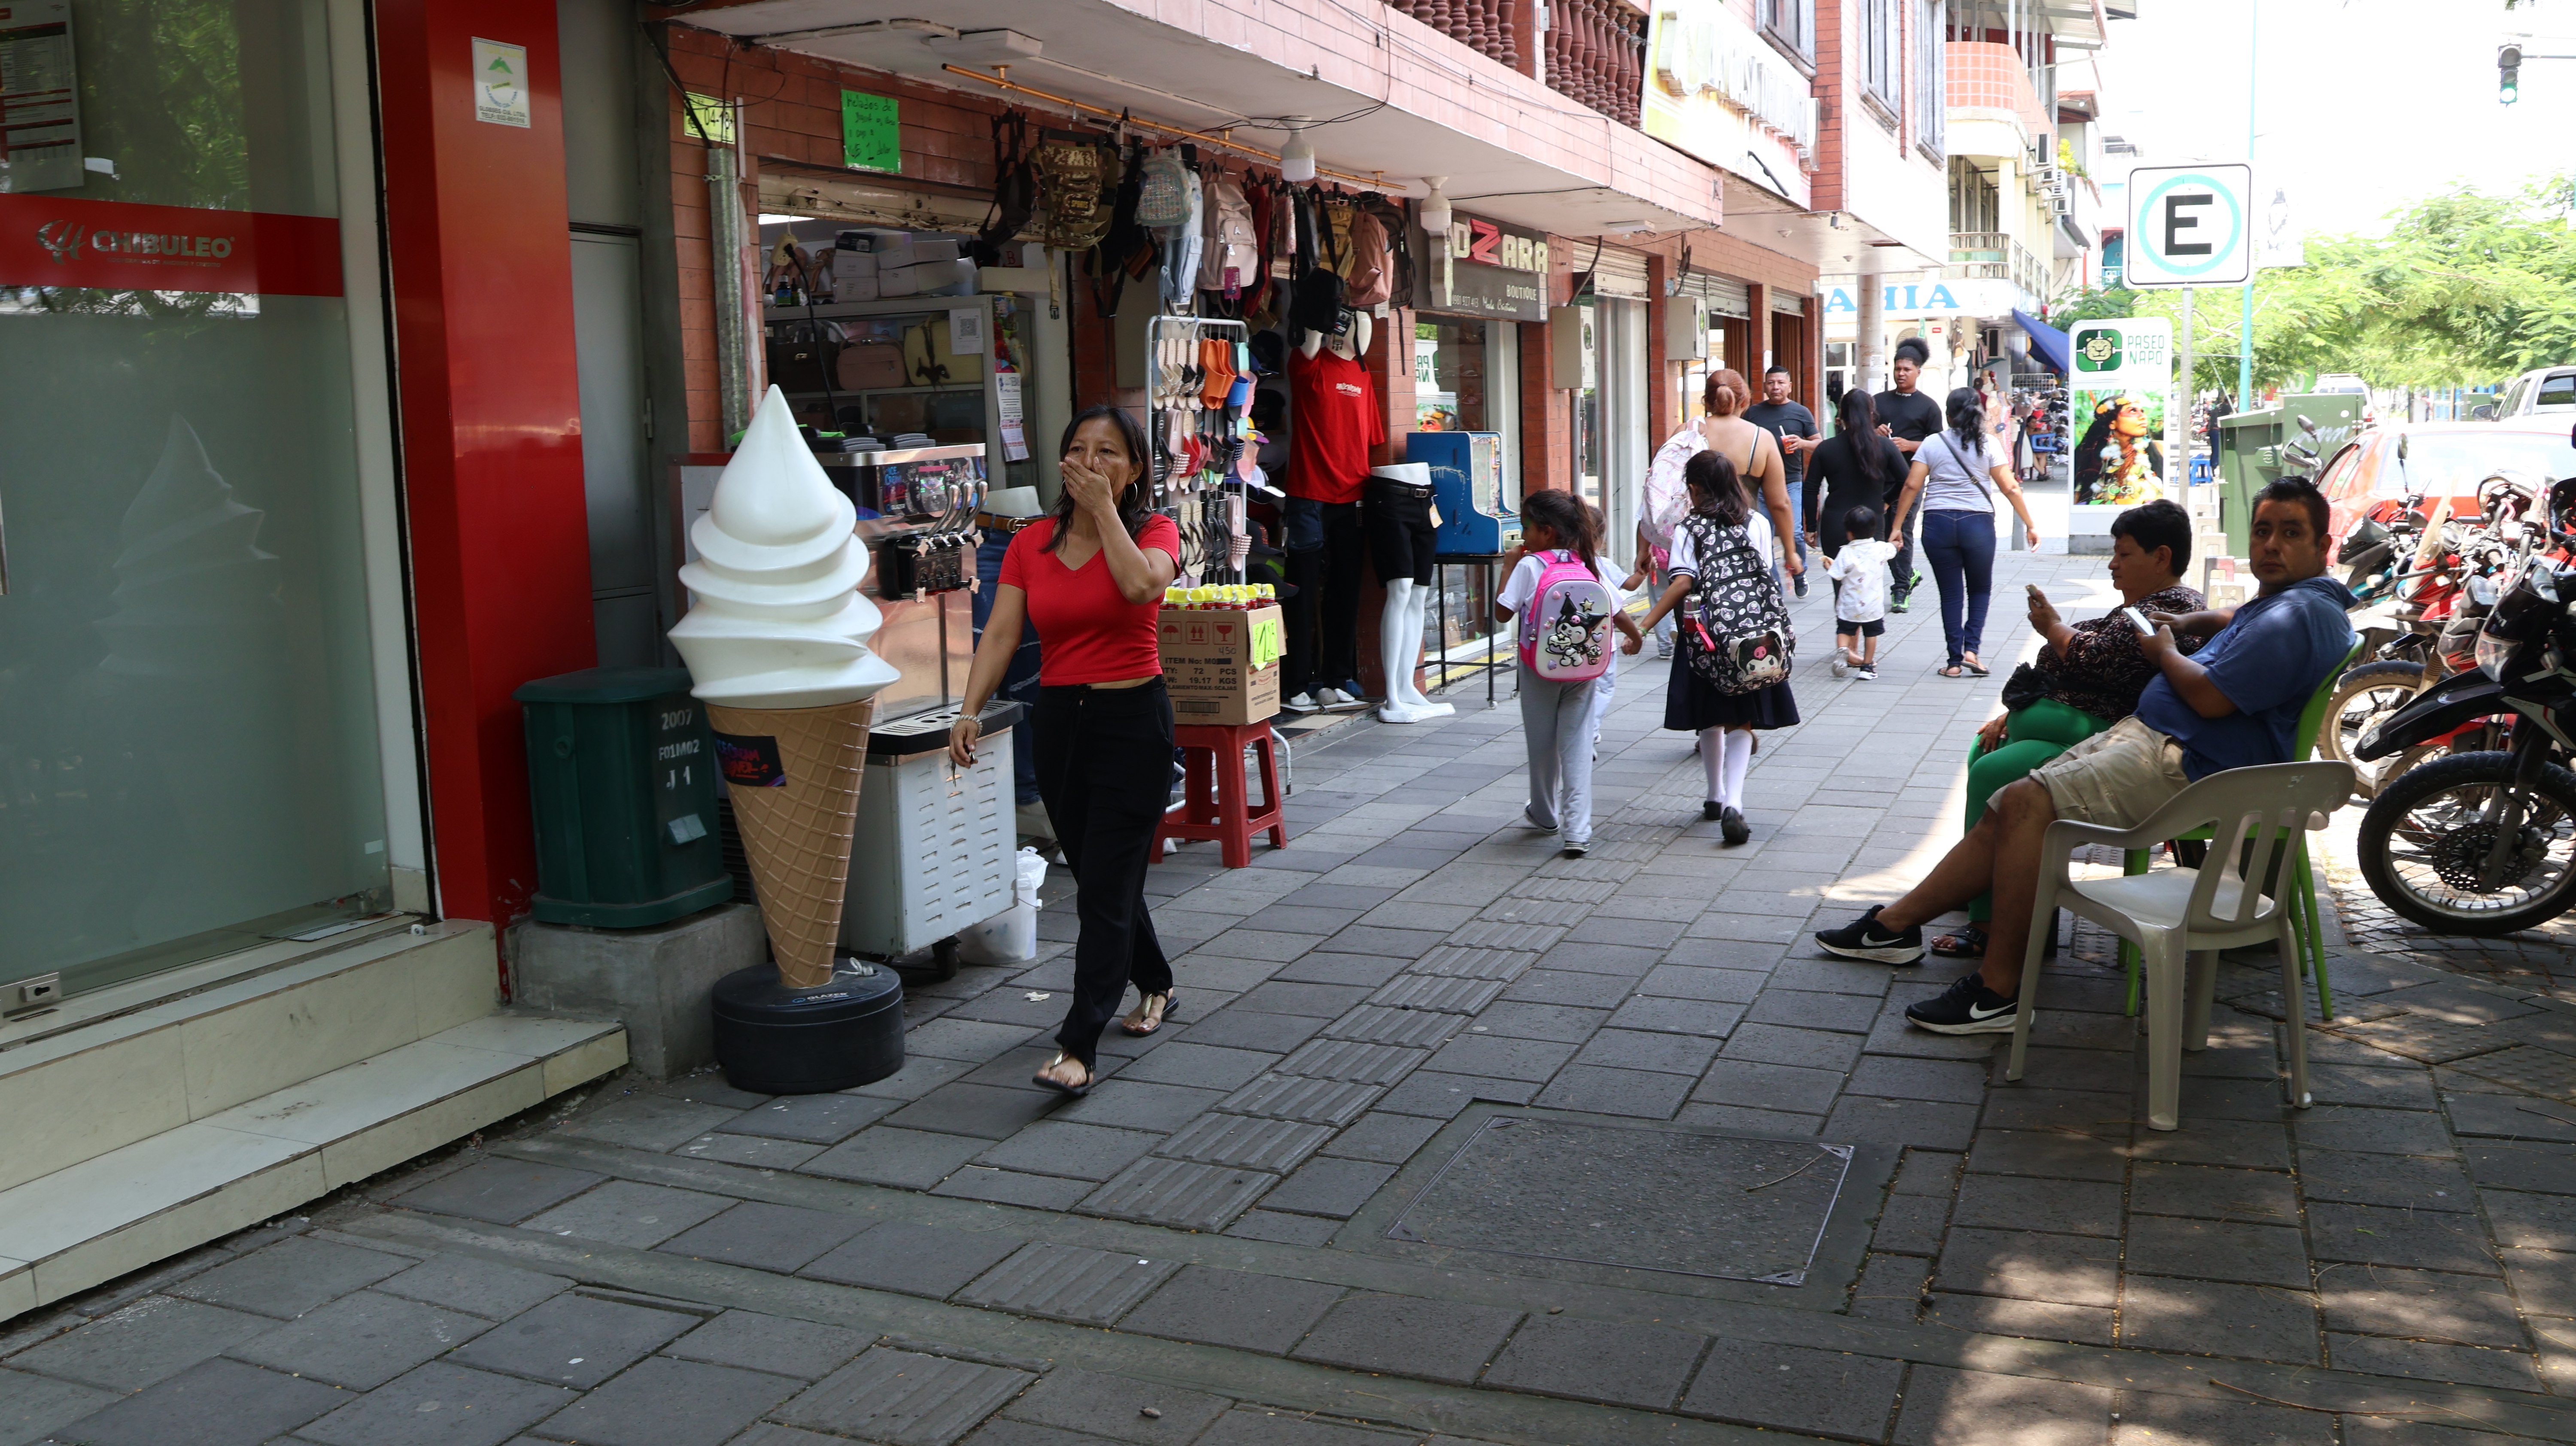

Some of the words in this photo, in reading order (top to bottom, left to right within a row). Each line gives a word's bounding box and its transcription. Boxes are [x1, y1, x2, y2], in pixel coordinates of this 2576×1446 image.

[2165, 194, 2213, 256] E
[92, 230, 232, 258] CHIBULEO
[1506, 284, 1537, 301] BOUTIQUE
[2127, 335, 2164, 349] PASEO
[2129, 350, 2162, 365] NAPO
[1218, 647, 1236, 656] 450
[661, 709, 693, 730] 2007
[666, 769, 676, 790] J
[683, 766, 691, 785] 1
[807, 992, 848, 1000] GLAZER
